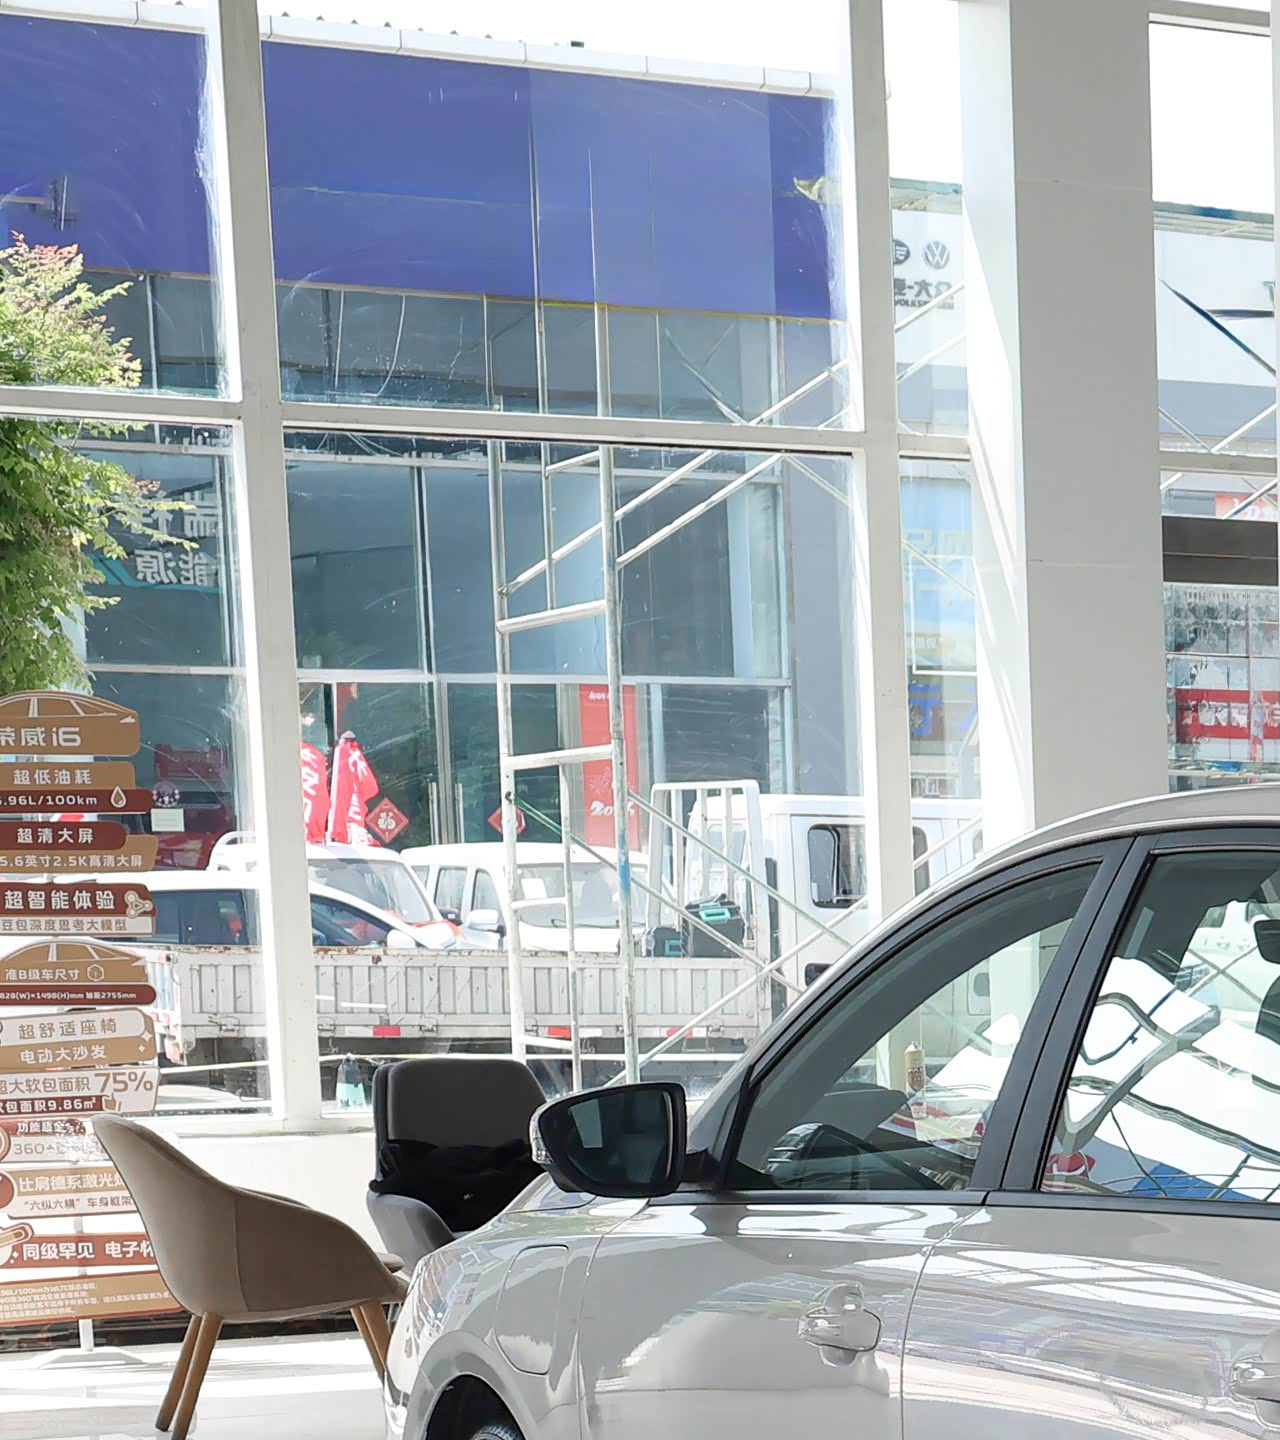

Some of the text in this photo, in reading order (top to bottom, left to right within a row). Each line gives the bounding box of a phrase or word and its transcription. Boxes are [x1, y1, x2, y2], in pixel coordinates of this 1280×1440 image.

[13, 769, 92, 785] 超低油耗
[0, 795, 98, 806] .96L/100km
[17, 827, 94, 844] 超清大屏
[4, 890, 115, 910] 超智能体验
[1, 919, 127, 932] 豆包深度思考大模型
[19, 1018, 117, 1040] 超舒适座椅
[20, 1045, 107, 1064] 电动大沙发
[95, 1071, 154, 1094] 75%
[23, 1242, 95, 1261] 同级罕见
